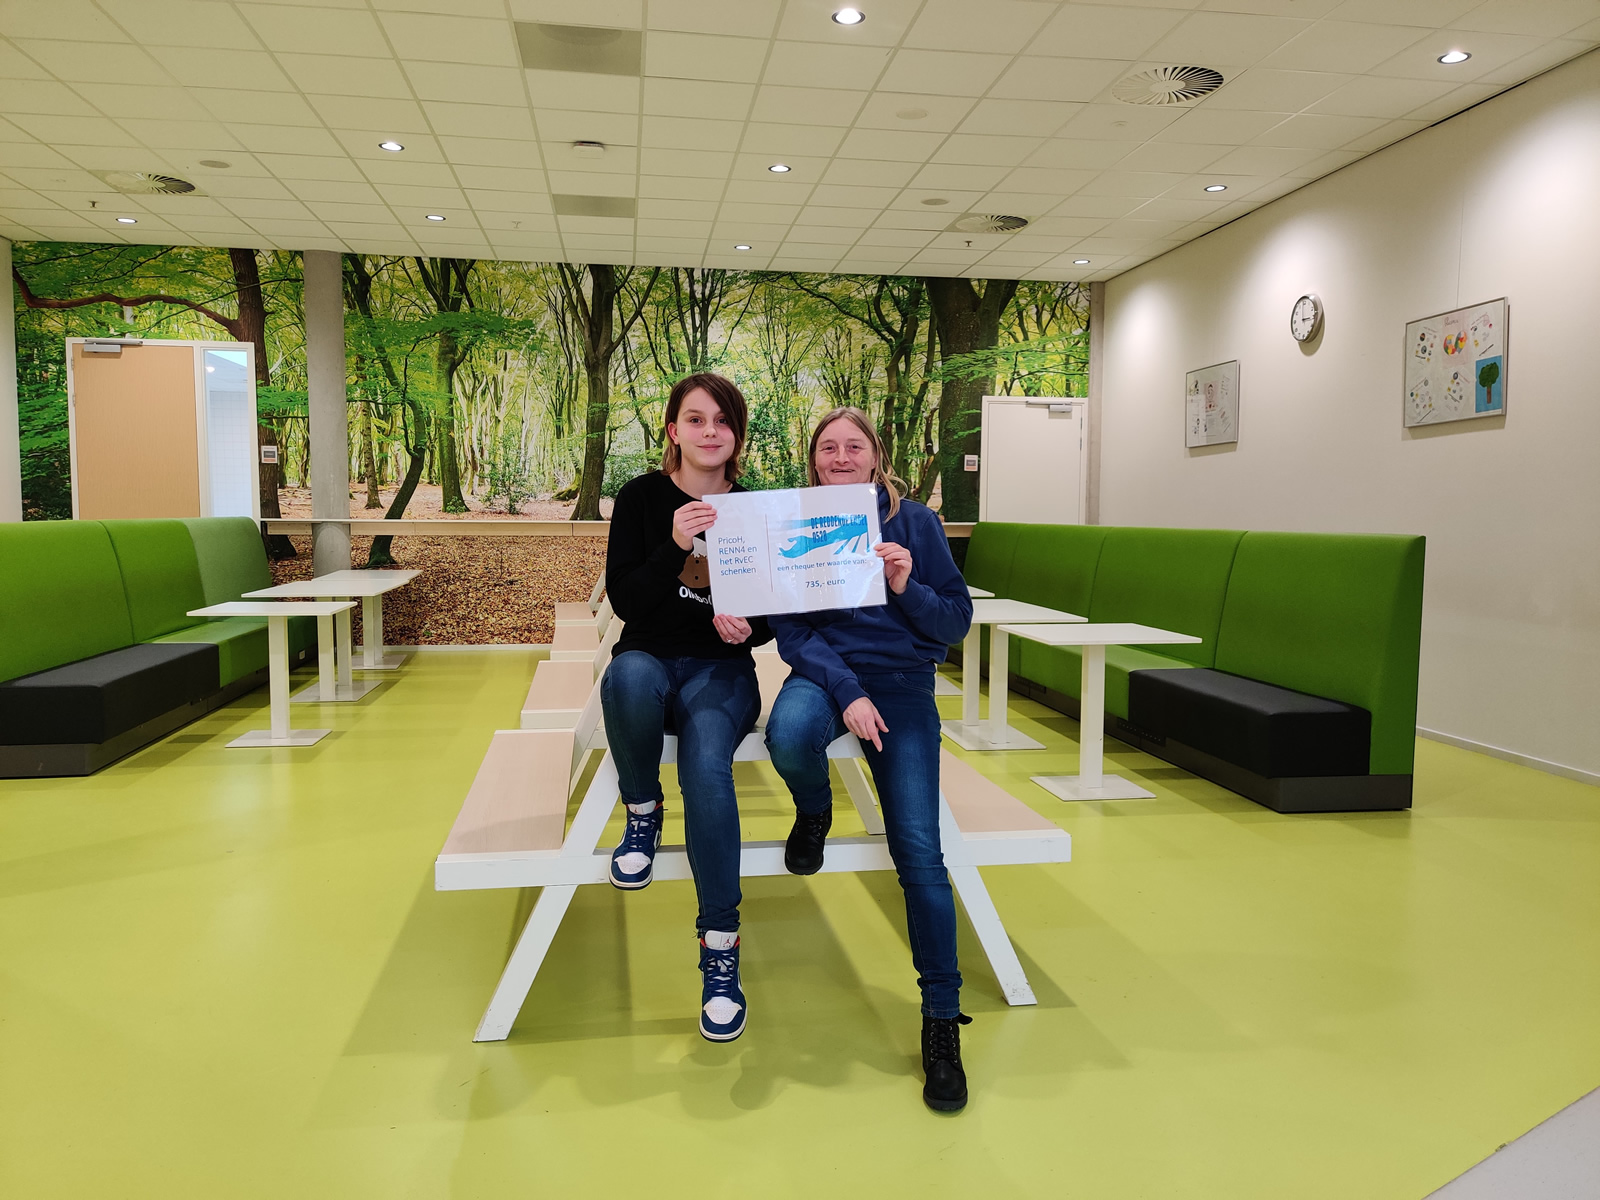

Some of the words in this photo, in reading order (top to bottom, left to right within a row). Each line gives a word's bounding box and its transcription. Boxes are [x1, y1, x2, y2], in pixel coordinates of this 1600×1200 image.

[810, 517, 819, 529] DE
[718, 535, 745, 545] PricoH,
[718, 546, 746, 555] RENN4
[719, 557, 733, 566] het
[734, 555, 754, 564] RvEC
[790, 562, 815, 572] cheque
[826, 558, 852, 567] waarde
[853, 558, 867, 566] van:
[720, 566, 757, 576] schenken
[805, 580, 825, 589] 735,-
[826, 578, 846, 586] euro
